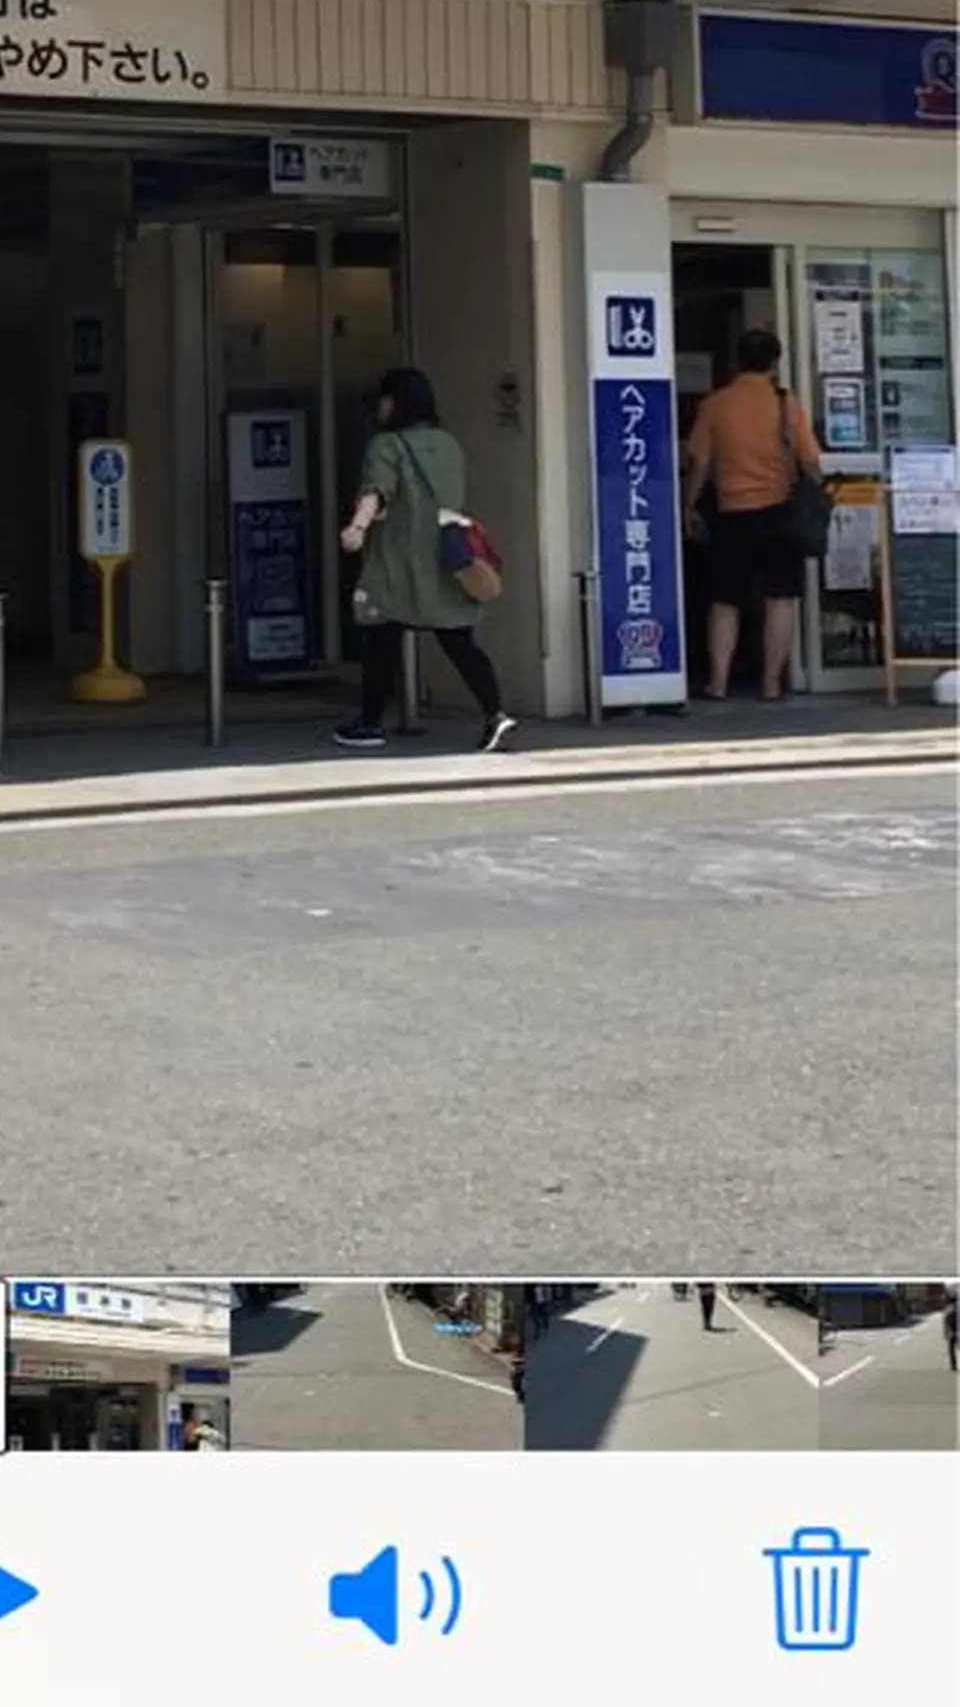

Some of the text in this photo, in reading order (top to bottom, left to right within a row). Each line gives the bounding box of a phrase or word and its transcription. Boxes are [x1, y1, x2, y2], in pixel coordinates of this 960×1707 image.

[620, 383, 652, 615] ヘアカット専門店
